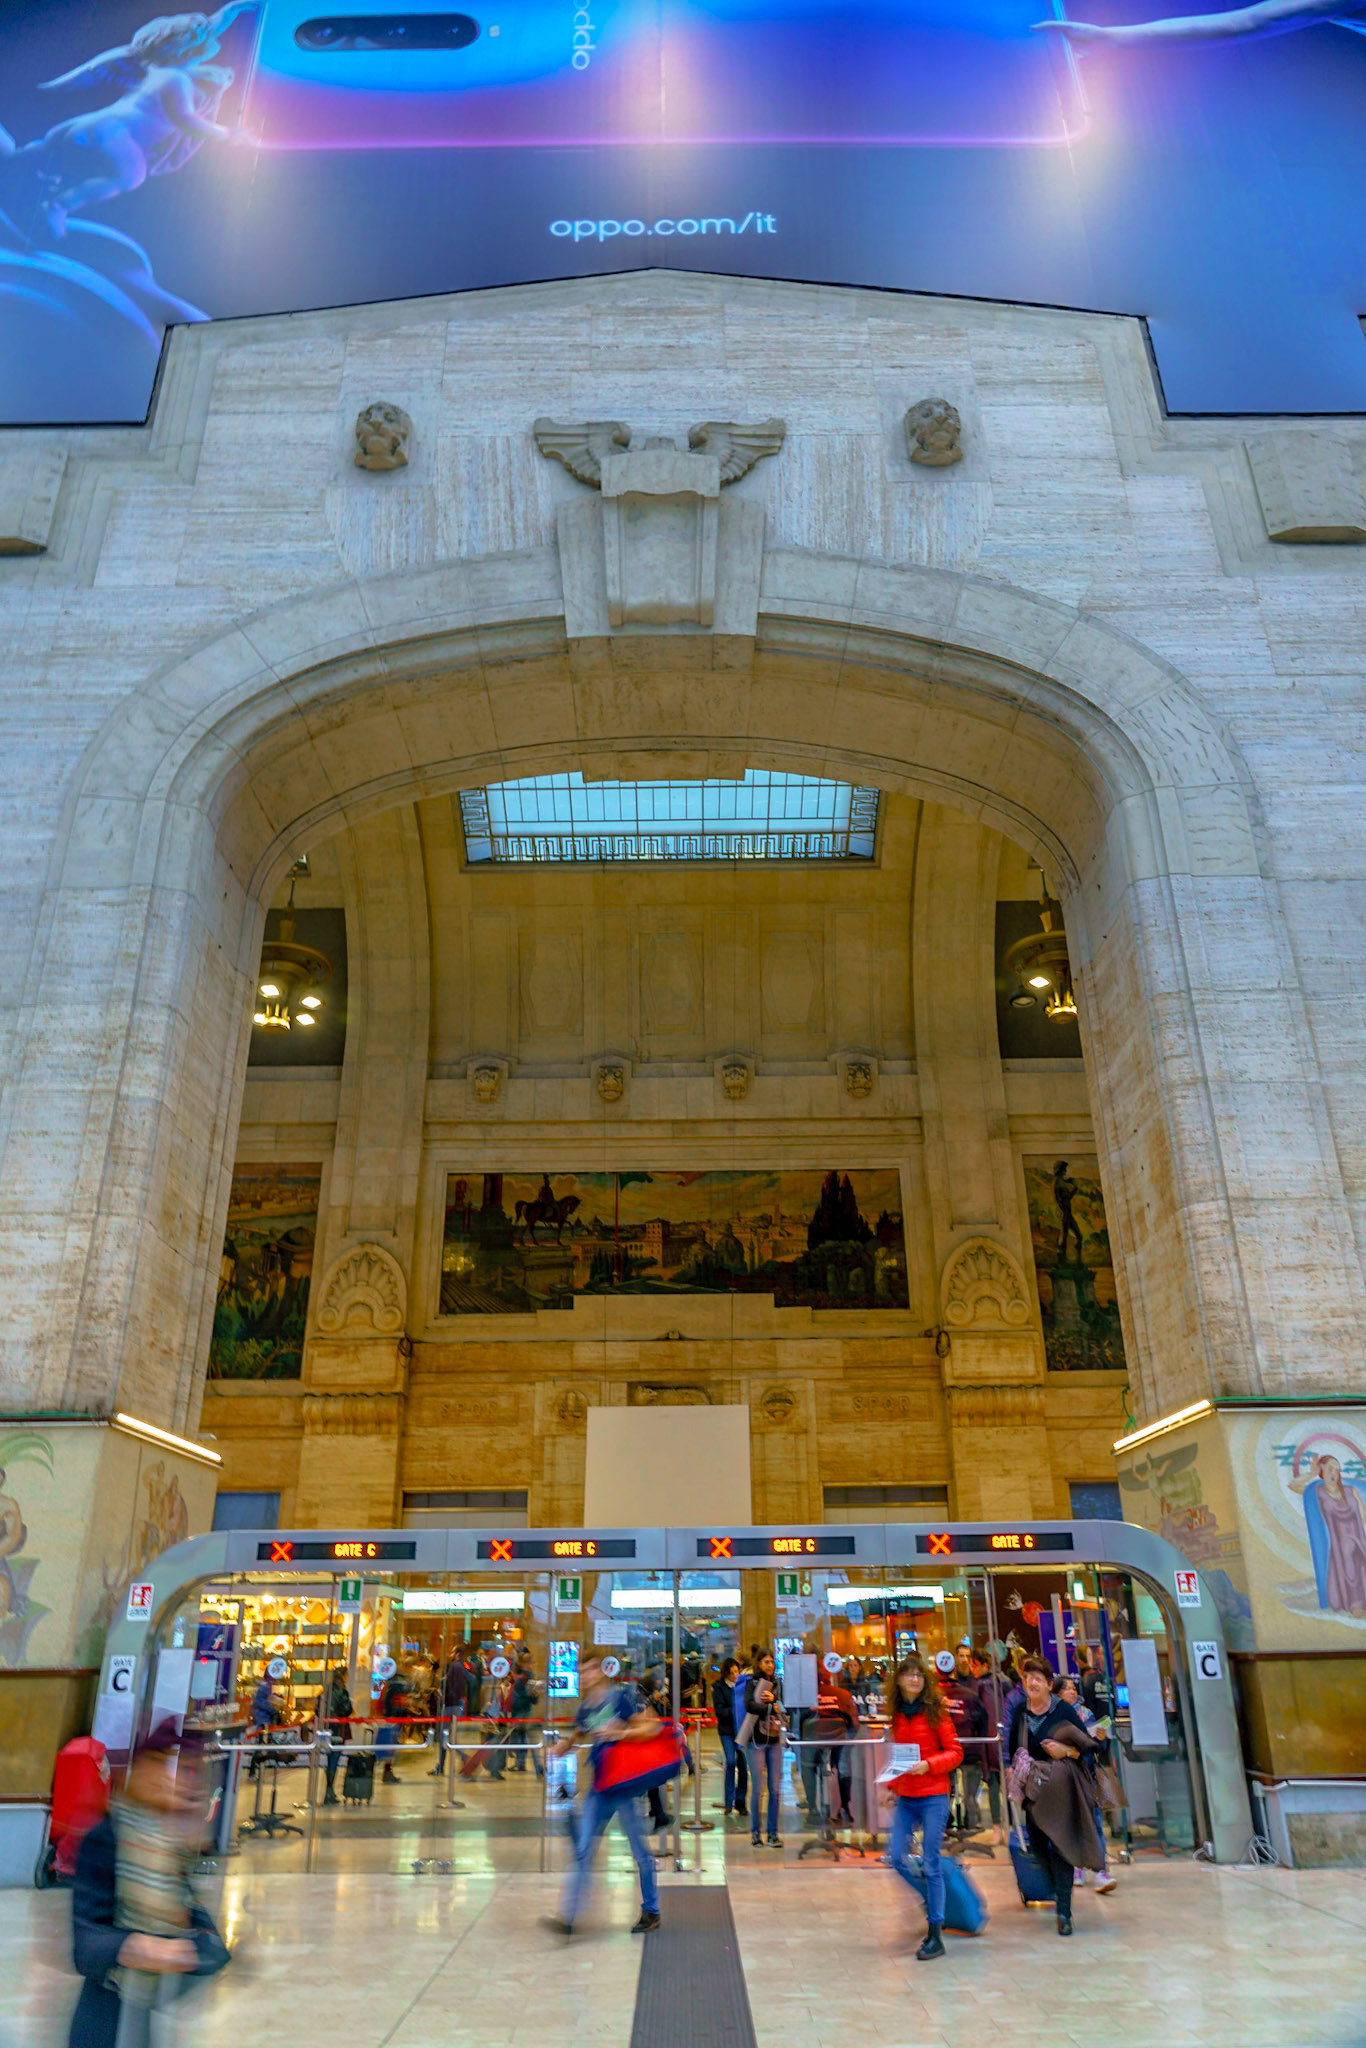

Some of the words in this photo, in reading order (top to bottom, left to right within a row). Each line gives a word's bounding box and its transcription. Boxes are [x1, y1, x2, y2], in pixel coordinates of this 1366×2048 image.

[549, 212, 777, 243] oppo.com/it
[553, 1541, 583, 1556] GATE
[586, 1541, 597, 1556] C
[772, 1539, 802, 1553] GATE
[805, 1538, 816, 1553] C
[990, 1535, 1021, 1549] GATE
[1023, 1534, 1035, 1549] C
[333, 1543, 363, 1557] GATE
[366, 1543, 377, 1557] C
[1201, 1654, 1218, 1678] C
[112, 1668, 130, 1692] C
